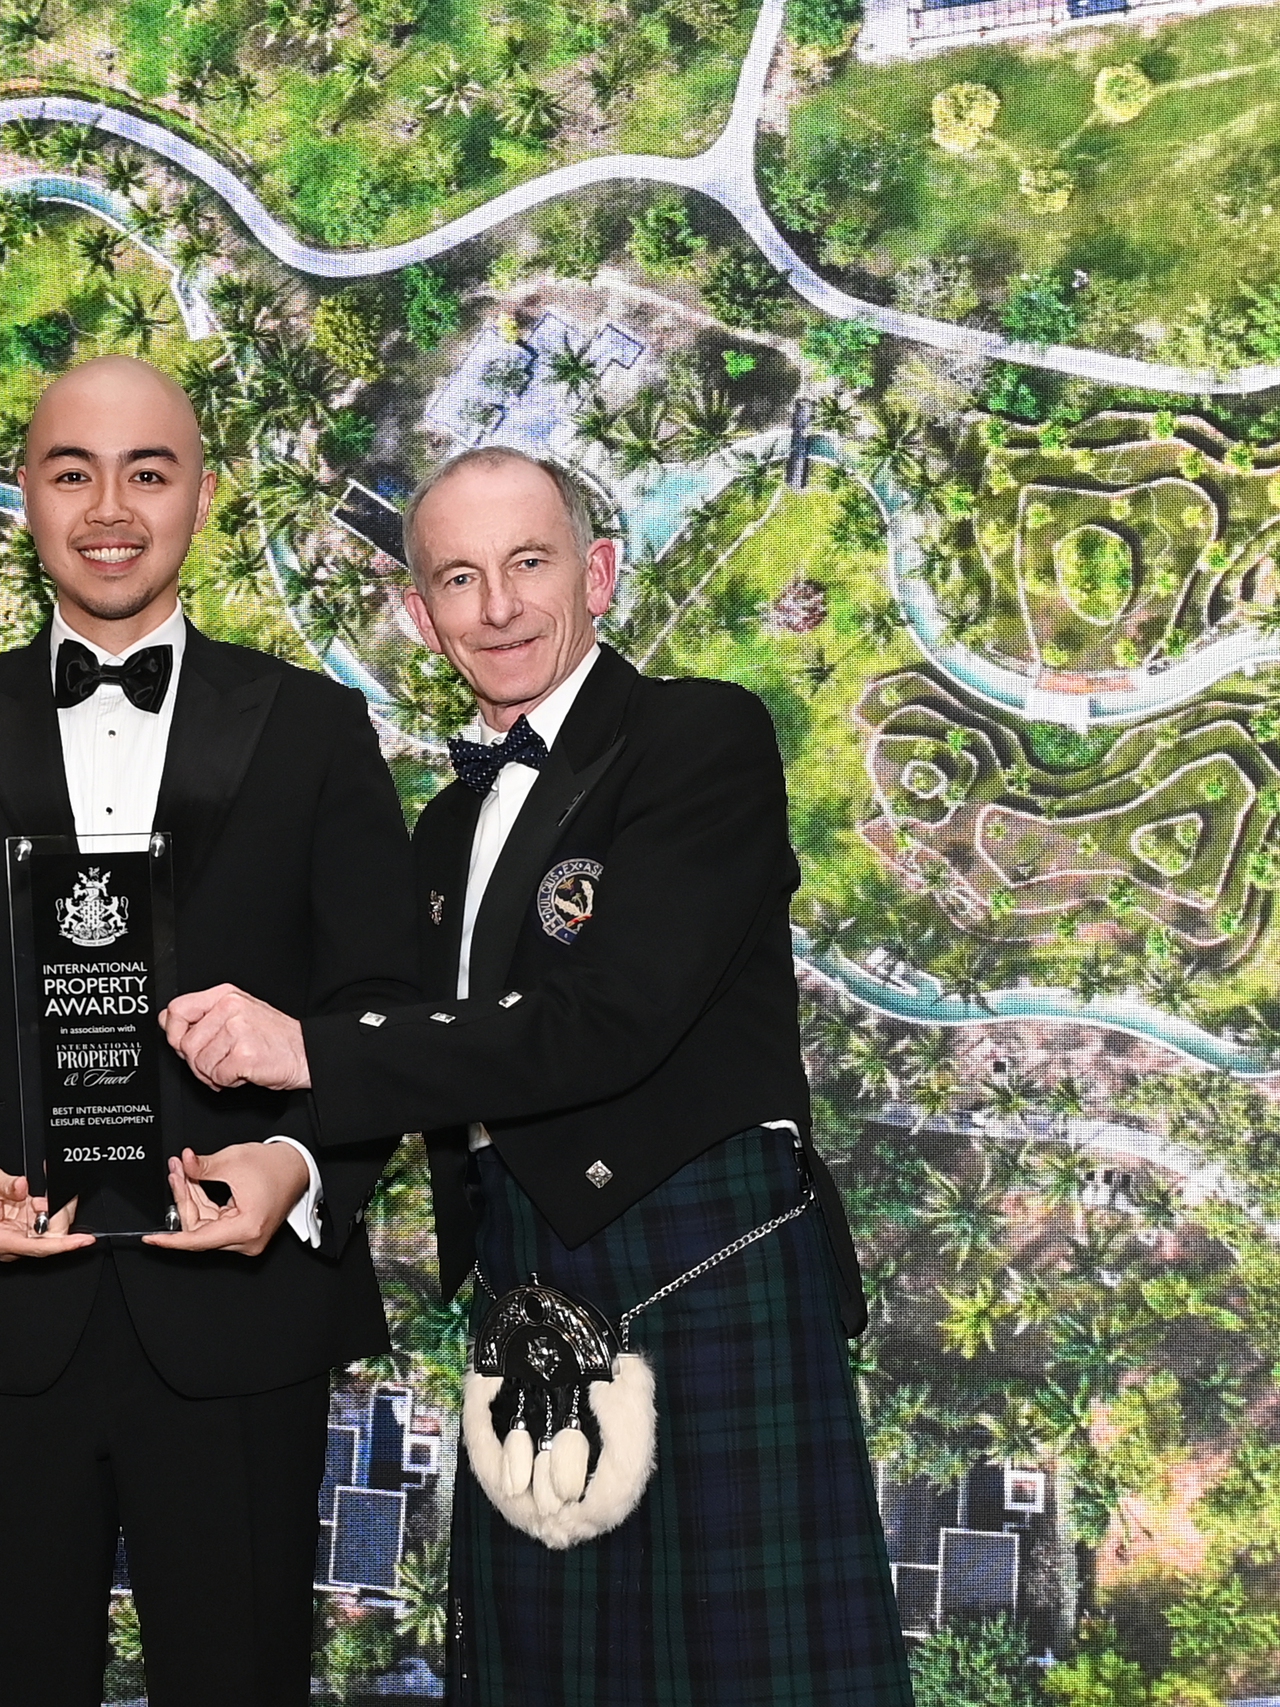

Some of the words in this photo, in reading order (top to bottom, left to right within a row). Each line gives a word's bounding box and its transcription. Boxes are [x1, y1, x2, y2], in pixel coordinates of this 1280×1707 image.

[562, 863, 580, 875] EX
[43, 961, 148, 975] INTERNATIONAL
[44, 976, 148, 996] PROPERTY
[44, 995, 150, 1018] AWARDS
[60, 1026, 69, 1035] in
[70, 1025, 116, 1035] association
[117, 1024, 136, 1034] with
[56, 1041, 142, 1051] INTERNATIONAL
[56, 1048, 142, 1069] PROPERTY
[63, 1072, 79, 1087] &
[83, 1068, 137, 1088] Travel
[52, 1106, 74, 1116] BEST
[76, 1104, 152, 1115] INTERNATIONAL
[50, 1117, 86, 1127] LEISURE
[87, 1115, 155, 1126] DEVELOPMENT
[63, 1145, 146, 1163] 2025-2026
